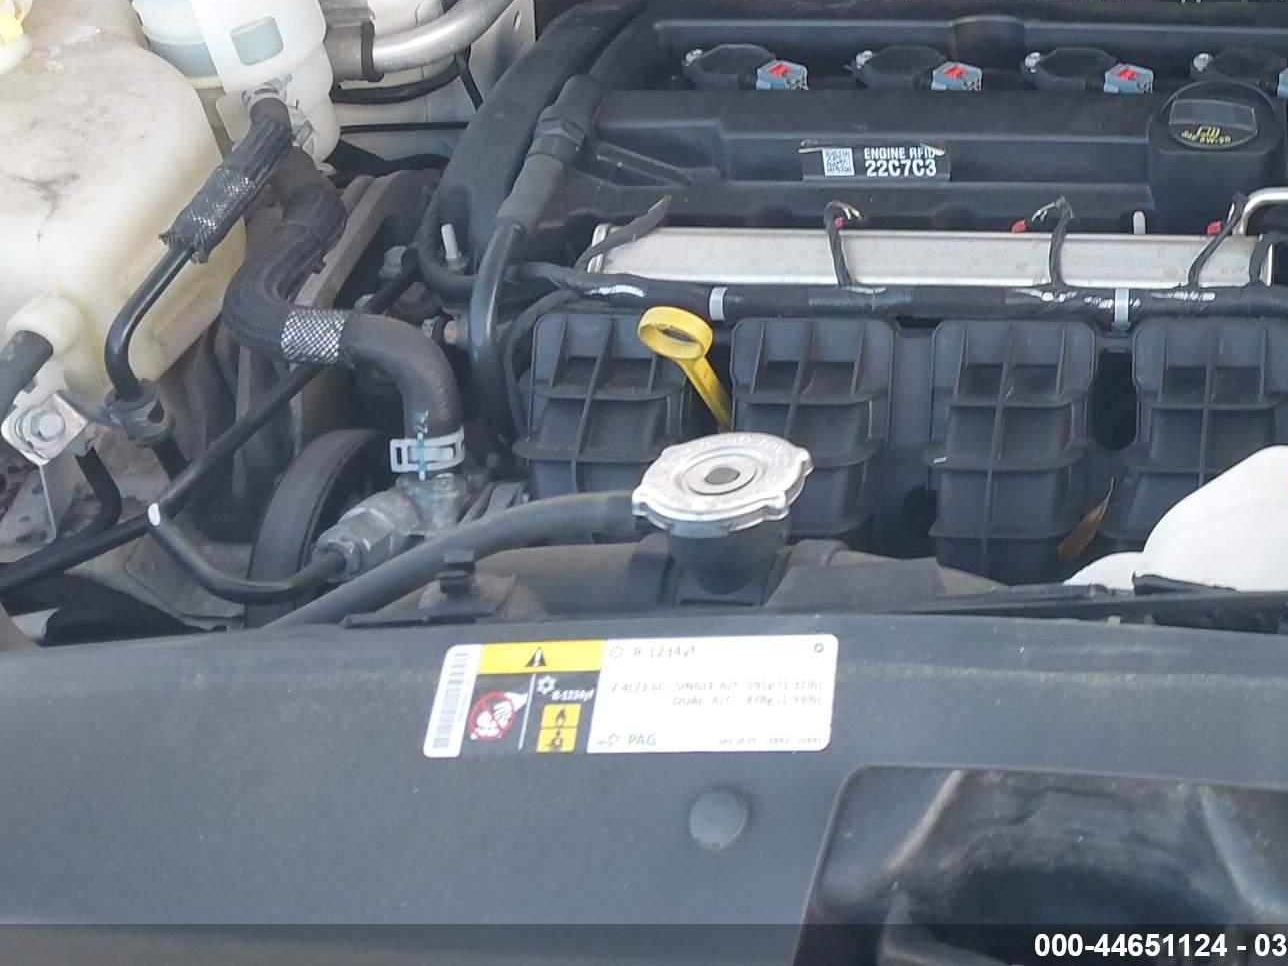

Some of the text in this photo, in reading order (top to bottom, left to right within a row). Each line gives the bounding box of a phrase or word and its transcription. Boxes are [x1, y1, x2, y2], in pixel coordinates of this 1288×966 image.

[863, 145, 936, 160] ENGINE RFID
[864, 158, 937, 177] 22C7C3
[627, 733, 657, 747] PAG
